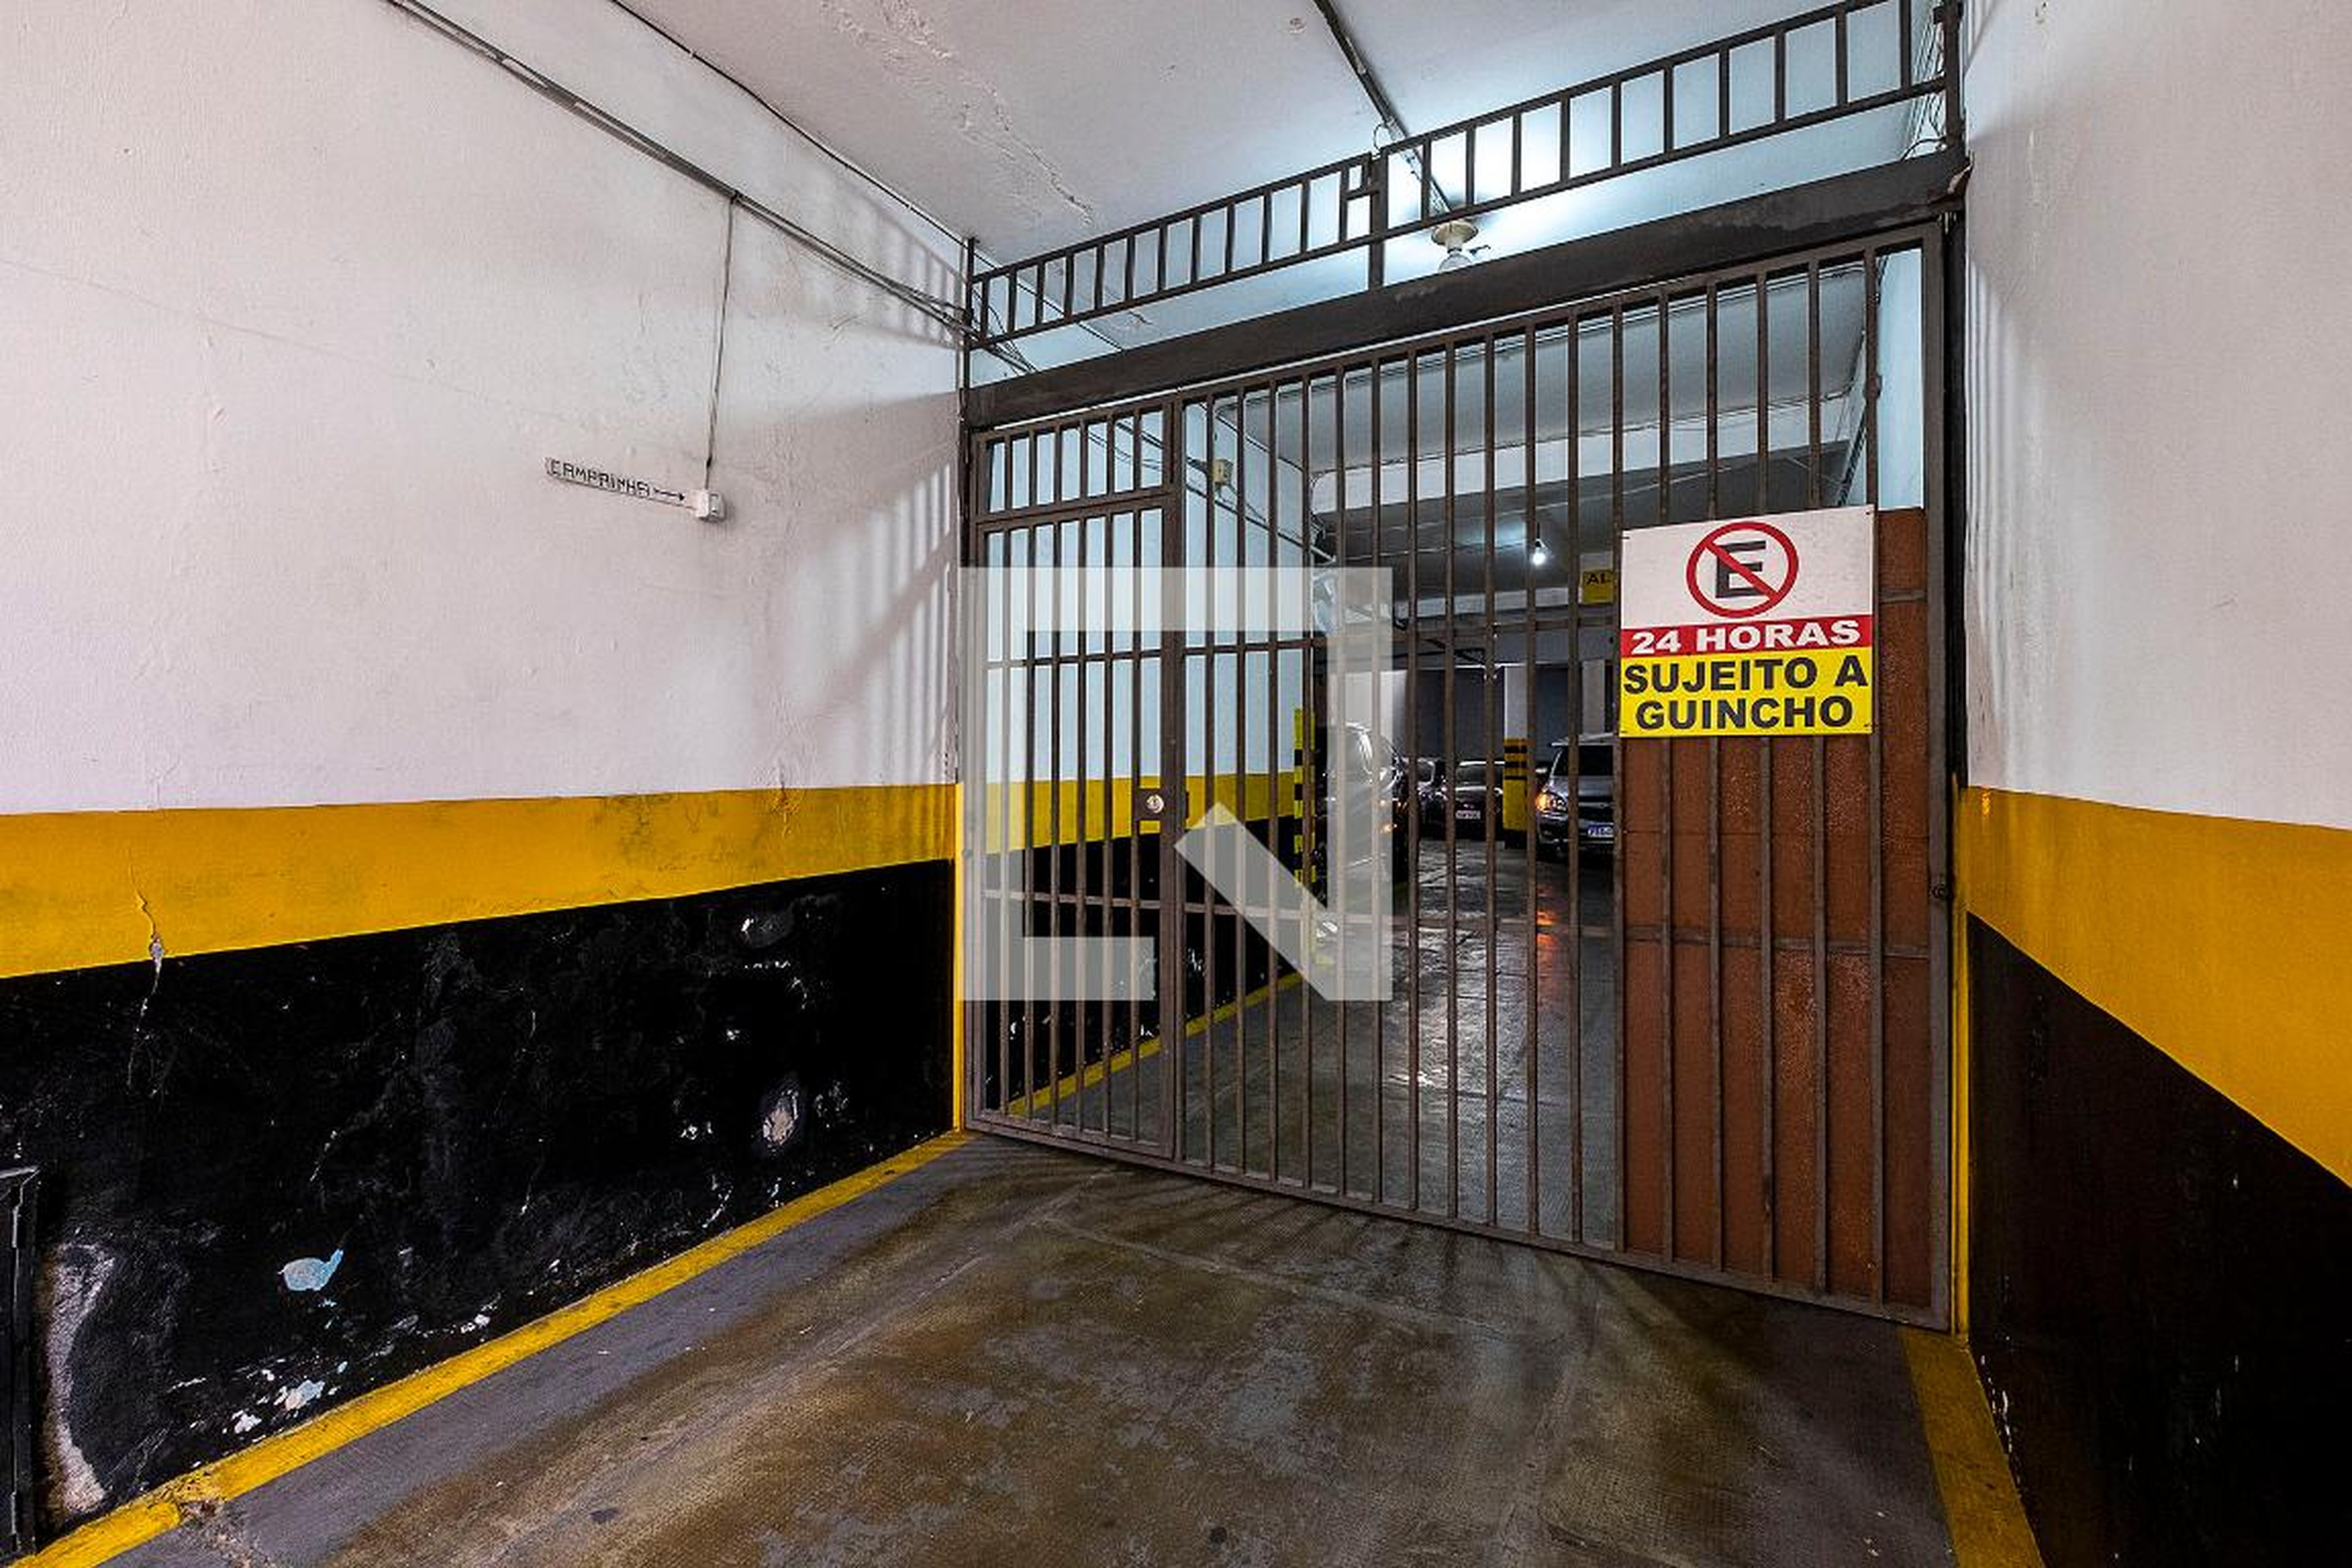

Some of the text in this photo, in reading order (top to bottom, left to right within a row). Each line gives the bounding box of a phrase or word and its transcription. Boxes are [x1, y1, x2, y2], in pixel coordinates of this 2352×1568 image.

[1631, 619, 1861, 655] 24 HORAS
[1624, 654, 1869, 695] SUJEITO A
[1635, 695, 1853, 730] GUINCHO
